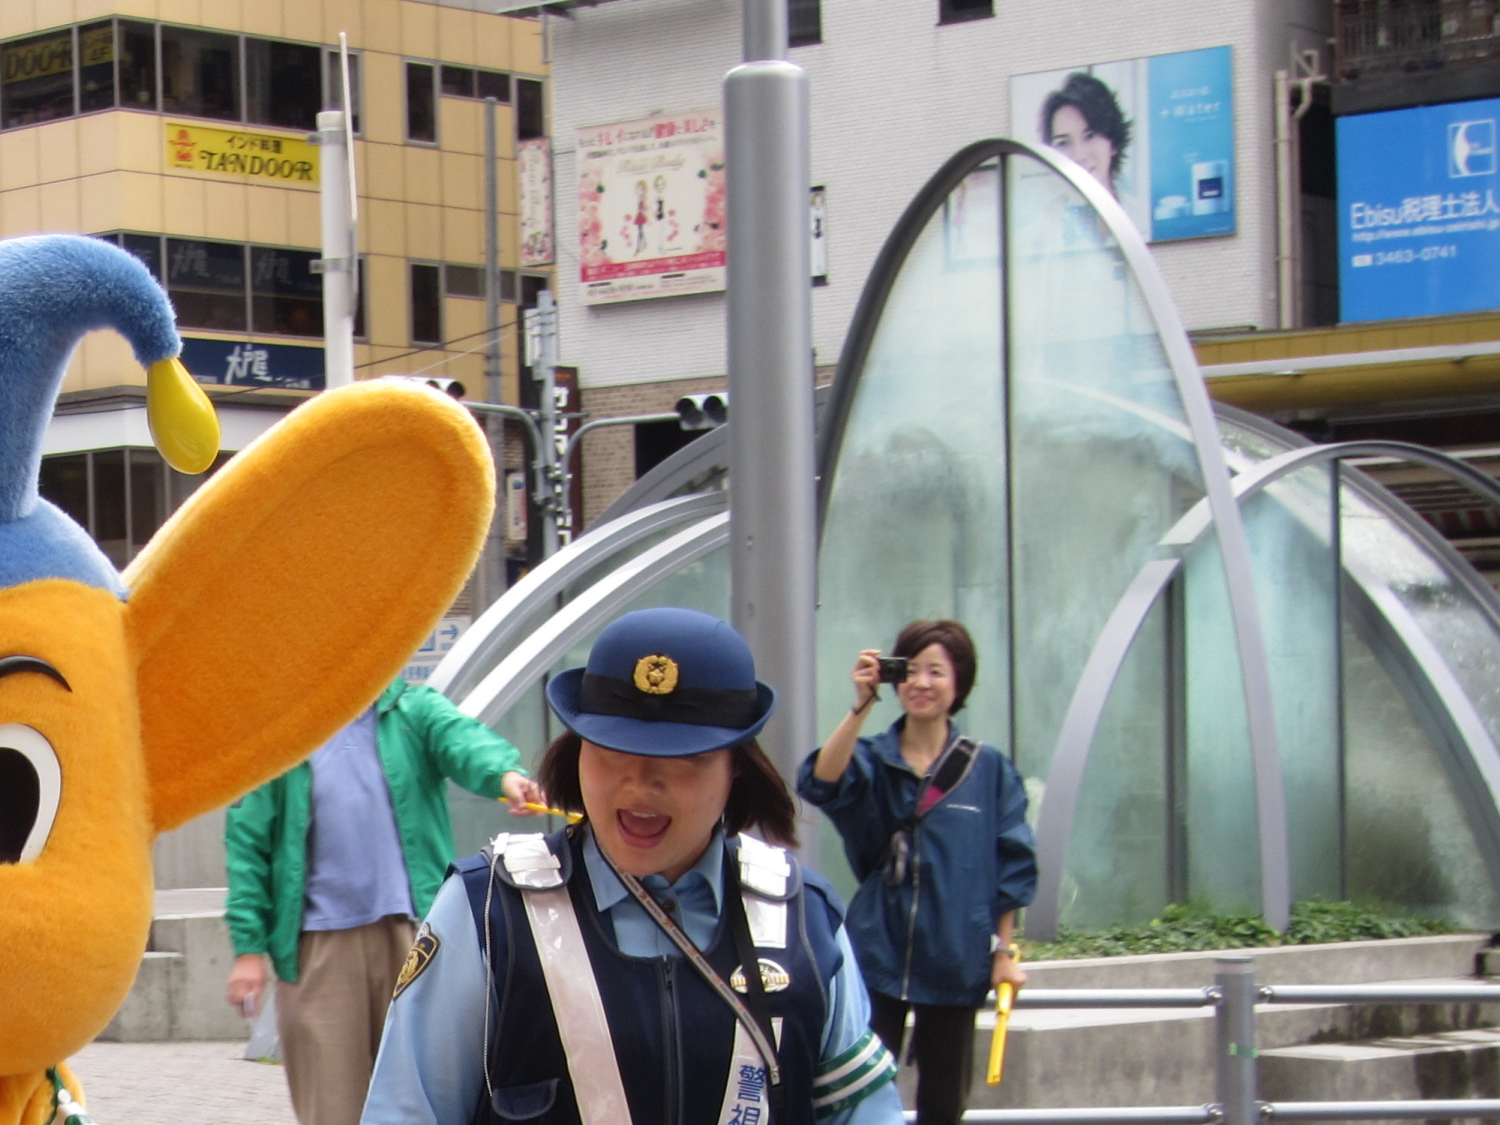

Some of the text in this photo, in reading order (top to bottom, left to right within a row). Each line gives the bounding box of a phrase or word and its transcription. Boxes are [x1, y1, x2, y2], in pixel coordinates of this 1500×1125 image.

[226, 134, 283, 154] インド料理
[199, 149, 314, 181] TANDOOR
[1351, 189, 1500, 229] Ebisu税理士法人
[224, 344, 273, 385] 大戸屋
